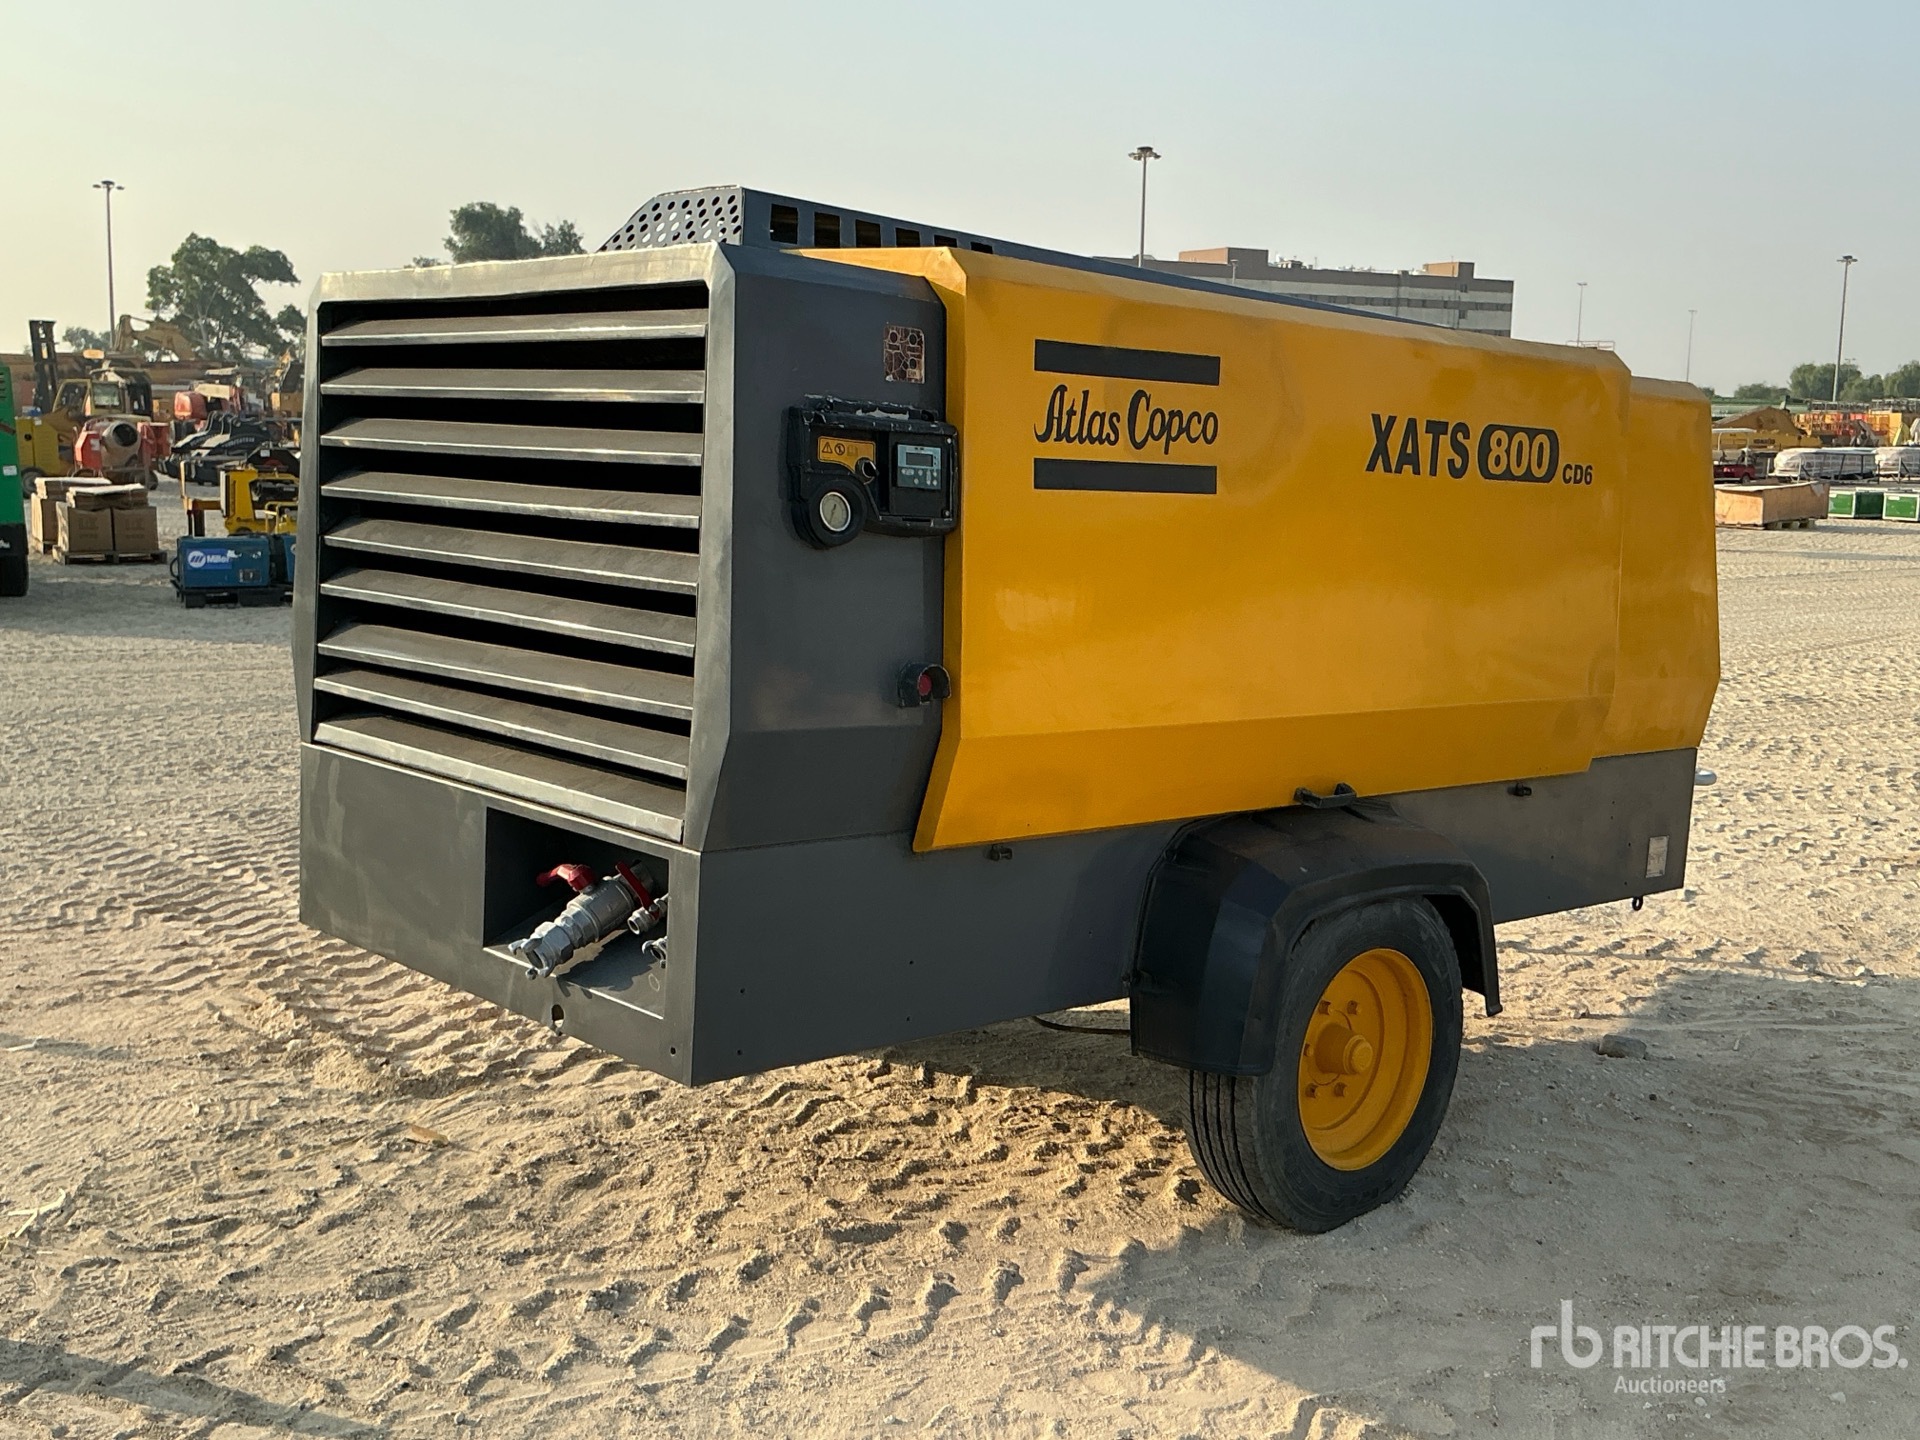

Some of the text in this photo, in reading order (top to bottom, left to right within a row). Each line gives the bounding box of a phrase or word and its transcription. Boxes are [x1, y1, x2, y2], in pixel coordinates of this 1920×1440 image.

[1033, 384, 1219, 456] Atlas Copco
[1365, 413, 1594, 486] XATS 800 CD6
